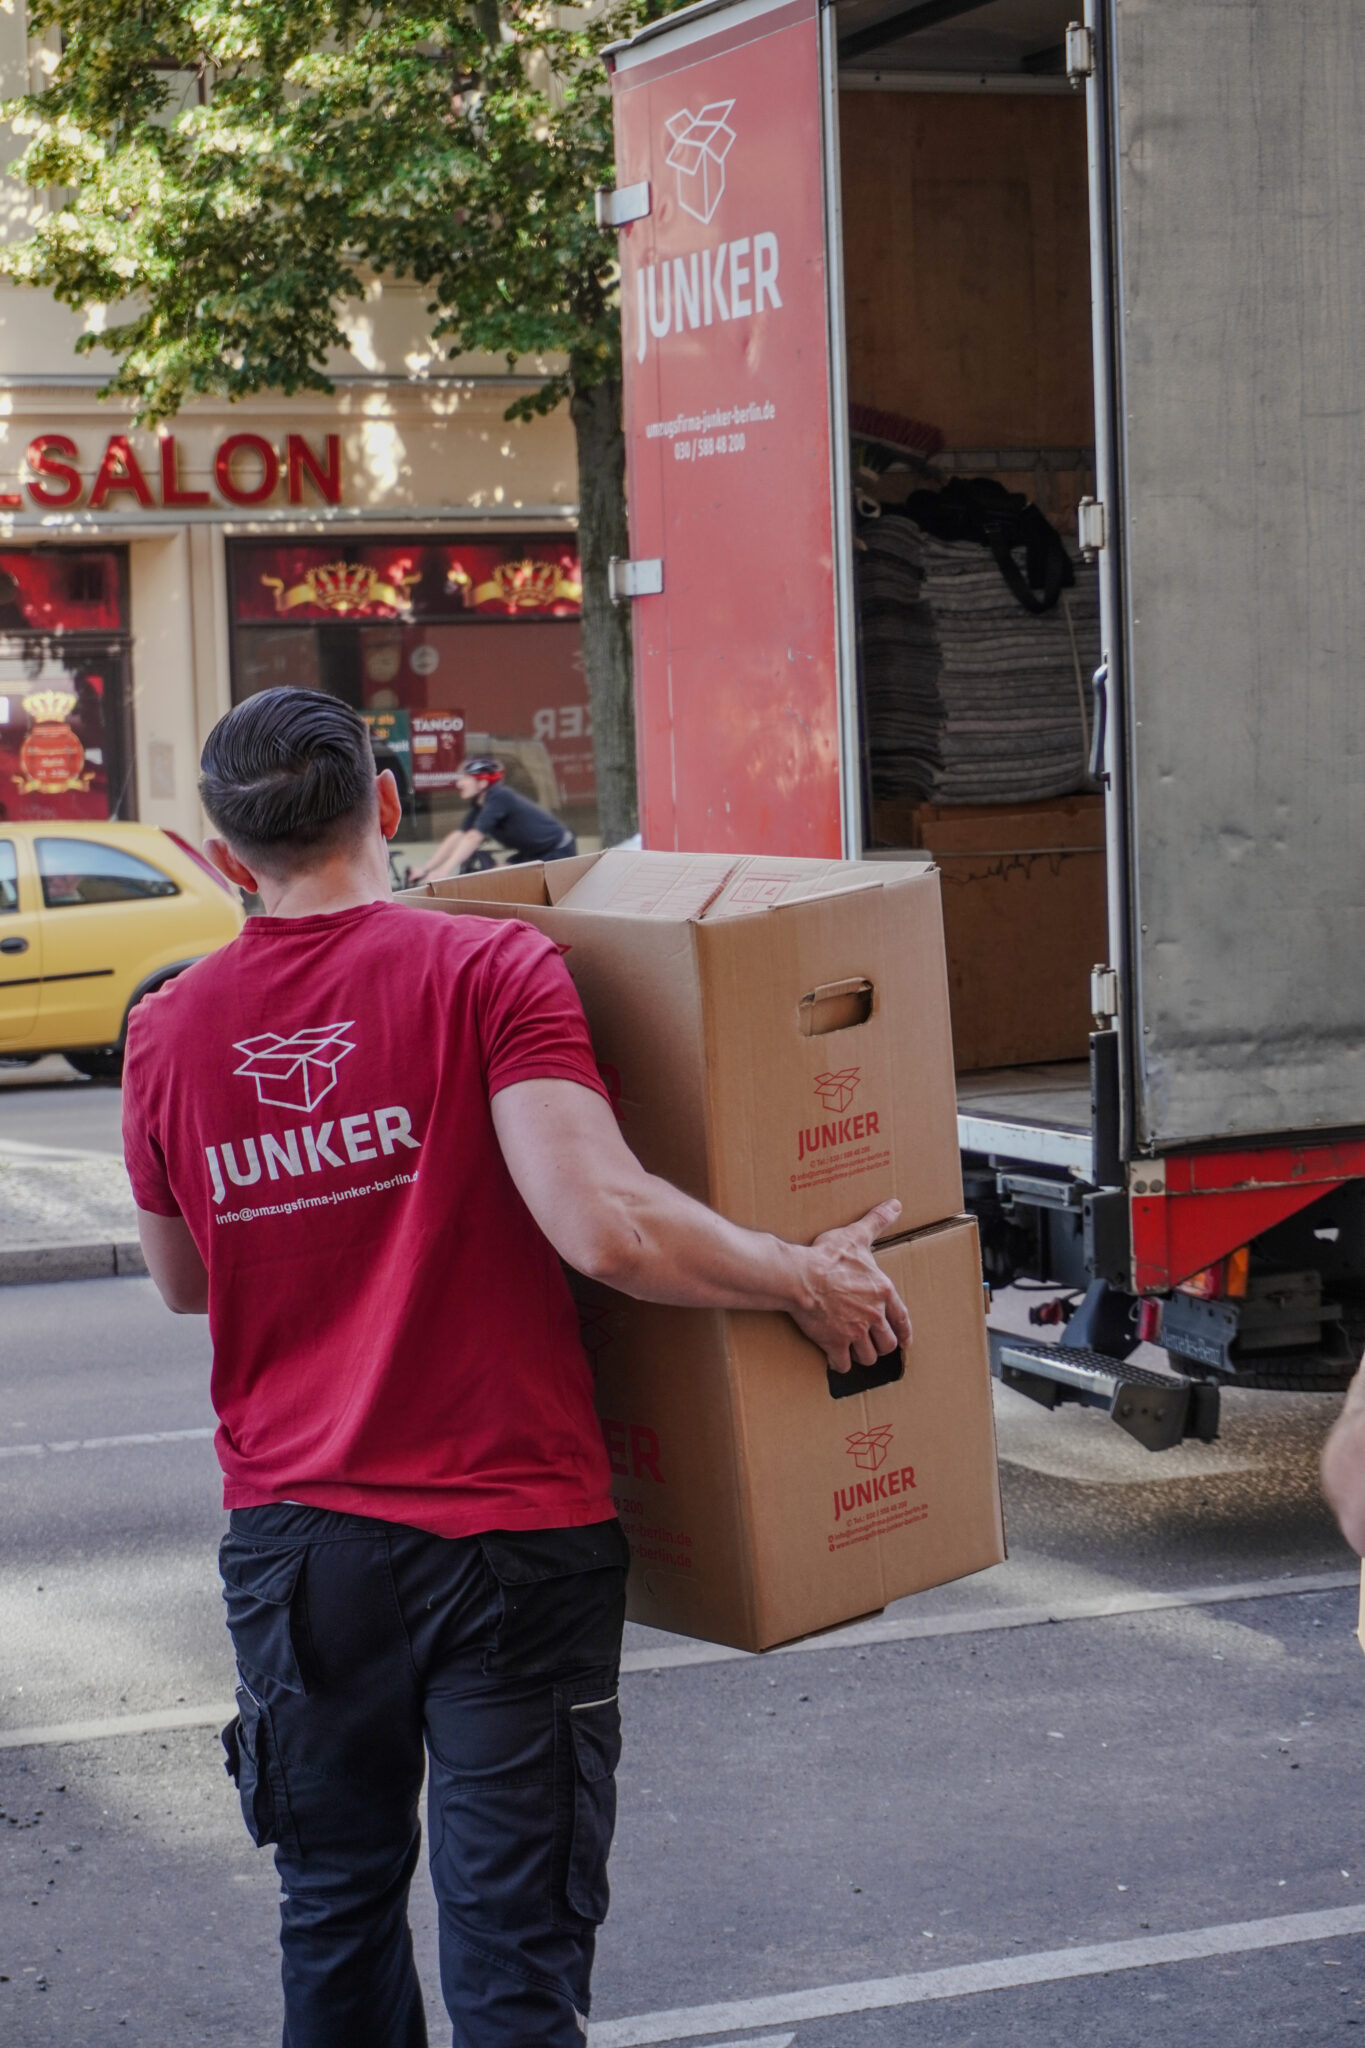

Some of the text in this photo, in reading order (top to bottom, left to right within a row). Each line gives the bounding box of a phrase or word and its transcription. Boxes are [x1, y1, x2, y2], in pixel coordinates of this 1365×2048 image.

[637, 231, 783, 365] JUNKER
[646, 400, 775, 439] umzugsfirma-junker-berlin.de
[674, 441, 690, 460] 030
[728, 433, 745, 453] 200
[205, 1105, 422, 1205] JUNKER
[798, 1111, 880, 1161] JUNKER
[623, 1498, 643, 1515] 200
[833, 1466, 917, 1522] JUNKER
[620, 1521, 692, 1547] er-berlin.de
